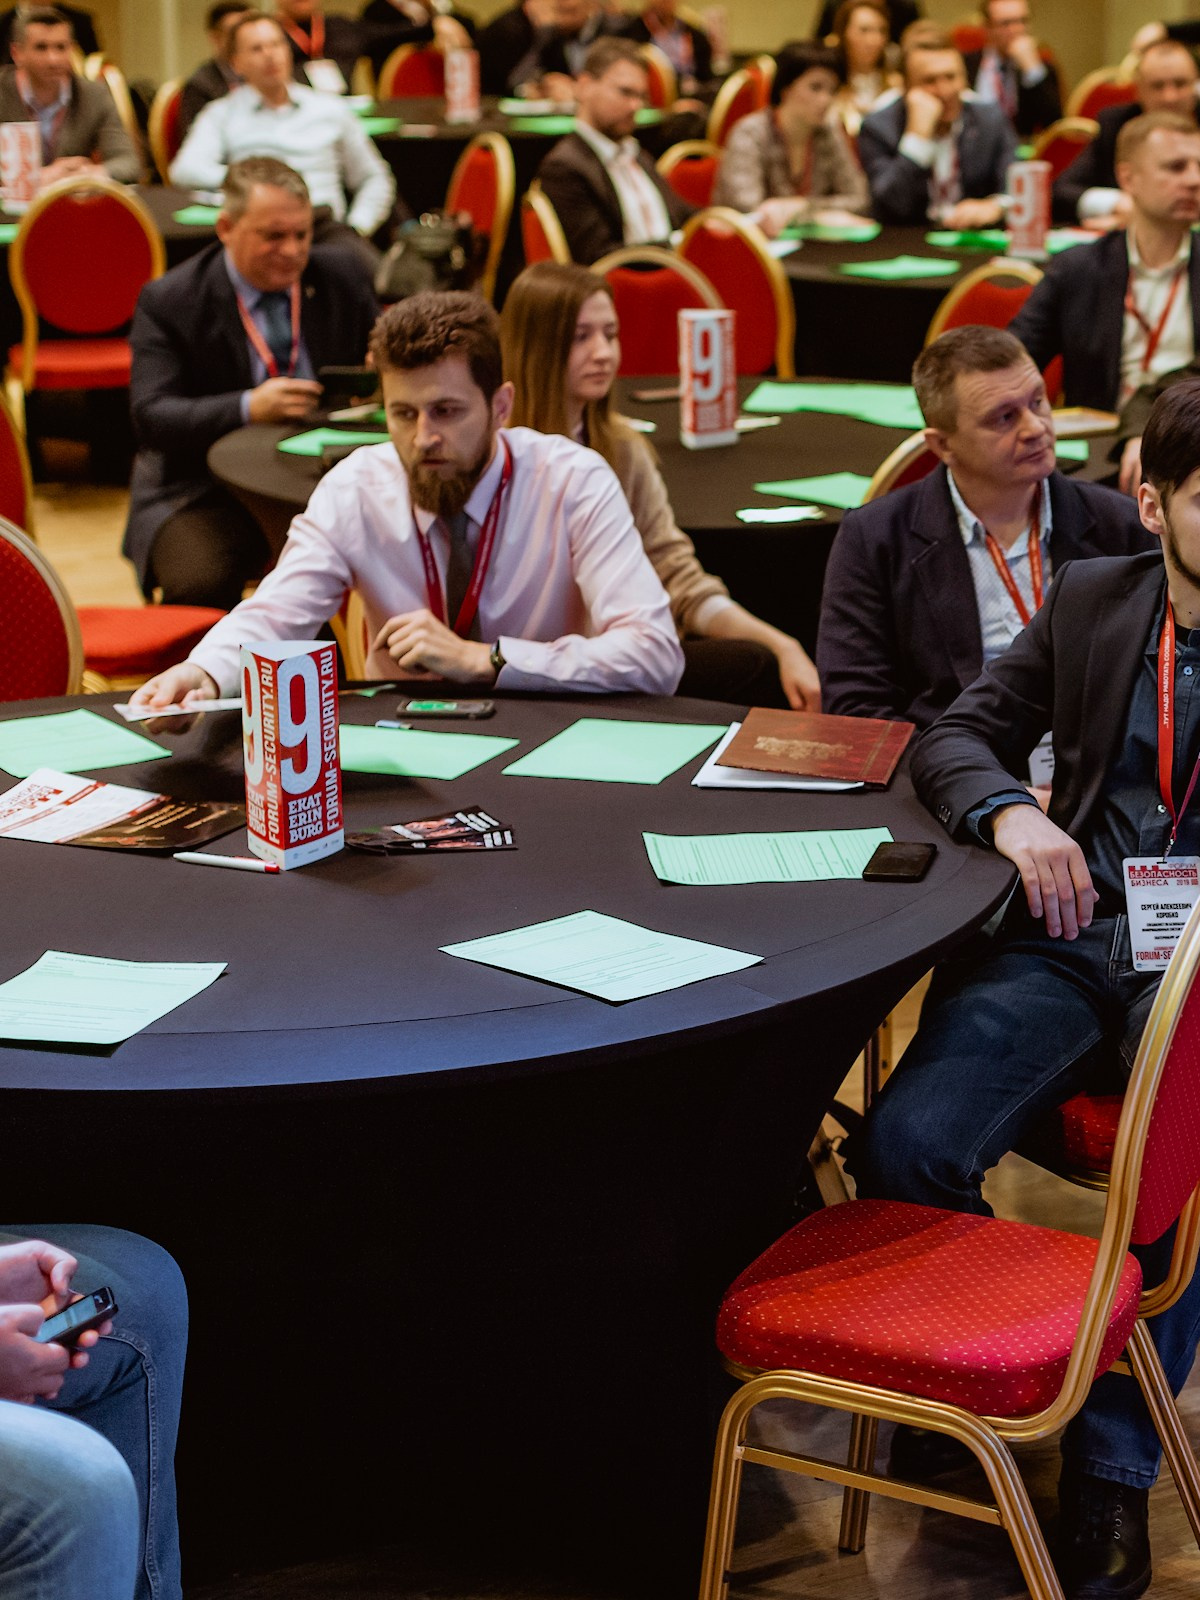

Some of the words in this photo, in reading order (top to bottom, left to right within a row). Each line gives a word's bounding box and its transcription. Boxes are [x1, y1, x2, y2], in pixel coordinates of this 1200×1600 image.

[693, 318, 723, 401] 9
[240, 650, 263, 787] 9
[277, 653, 322, 796] 9
[260, 660, 281, 845] FORUM-SECURITY.RU
[320, 649, 340, 832] FORUM-SECURITY.RU
[288, 792, 322, 815] EKAT
[289, 806, 323, 829] ERIN
[289, 820, 323, 844] BURG
[1130, 870, 1198, 879] БЕЗОПАСНОСТЬ
[1131, 879, 1169, 887] БИЗНЕСА
[1136, 951, 1173, 960] FORUM-SE
